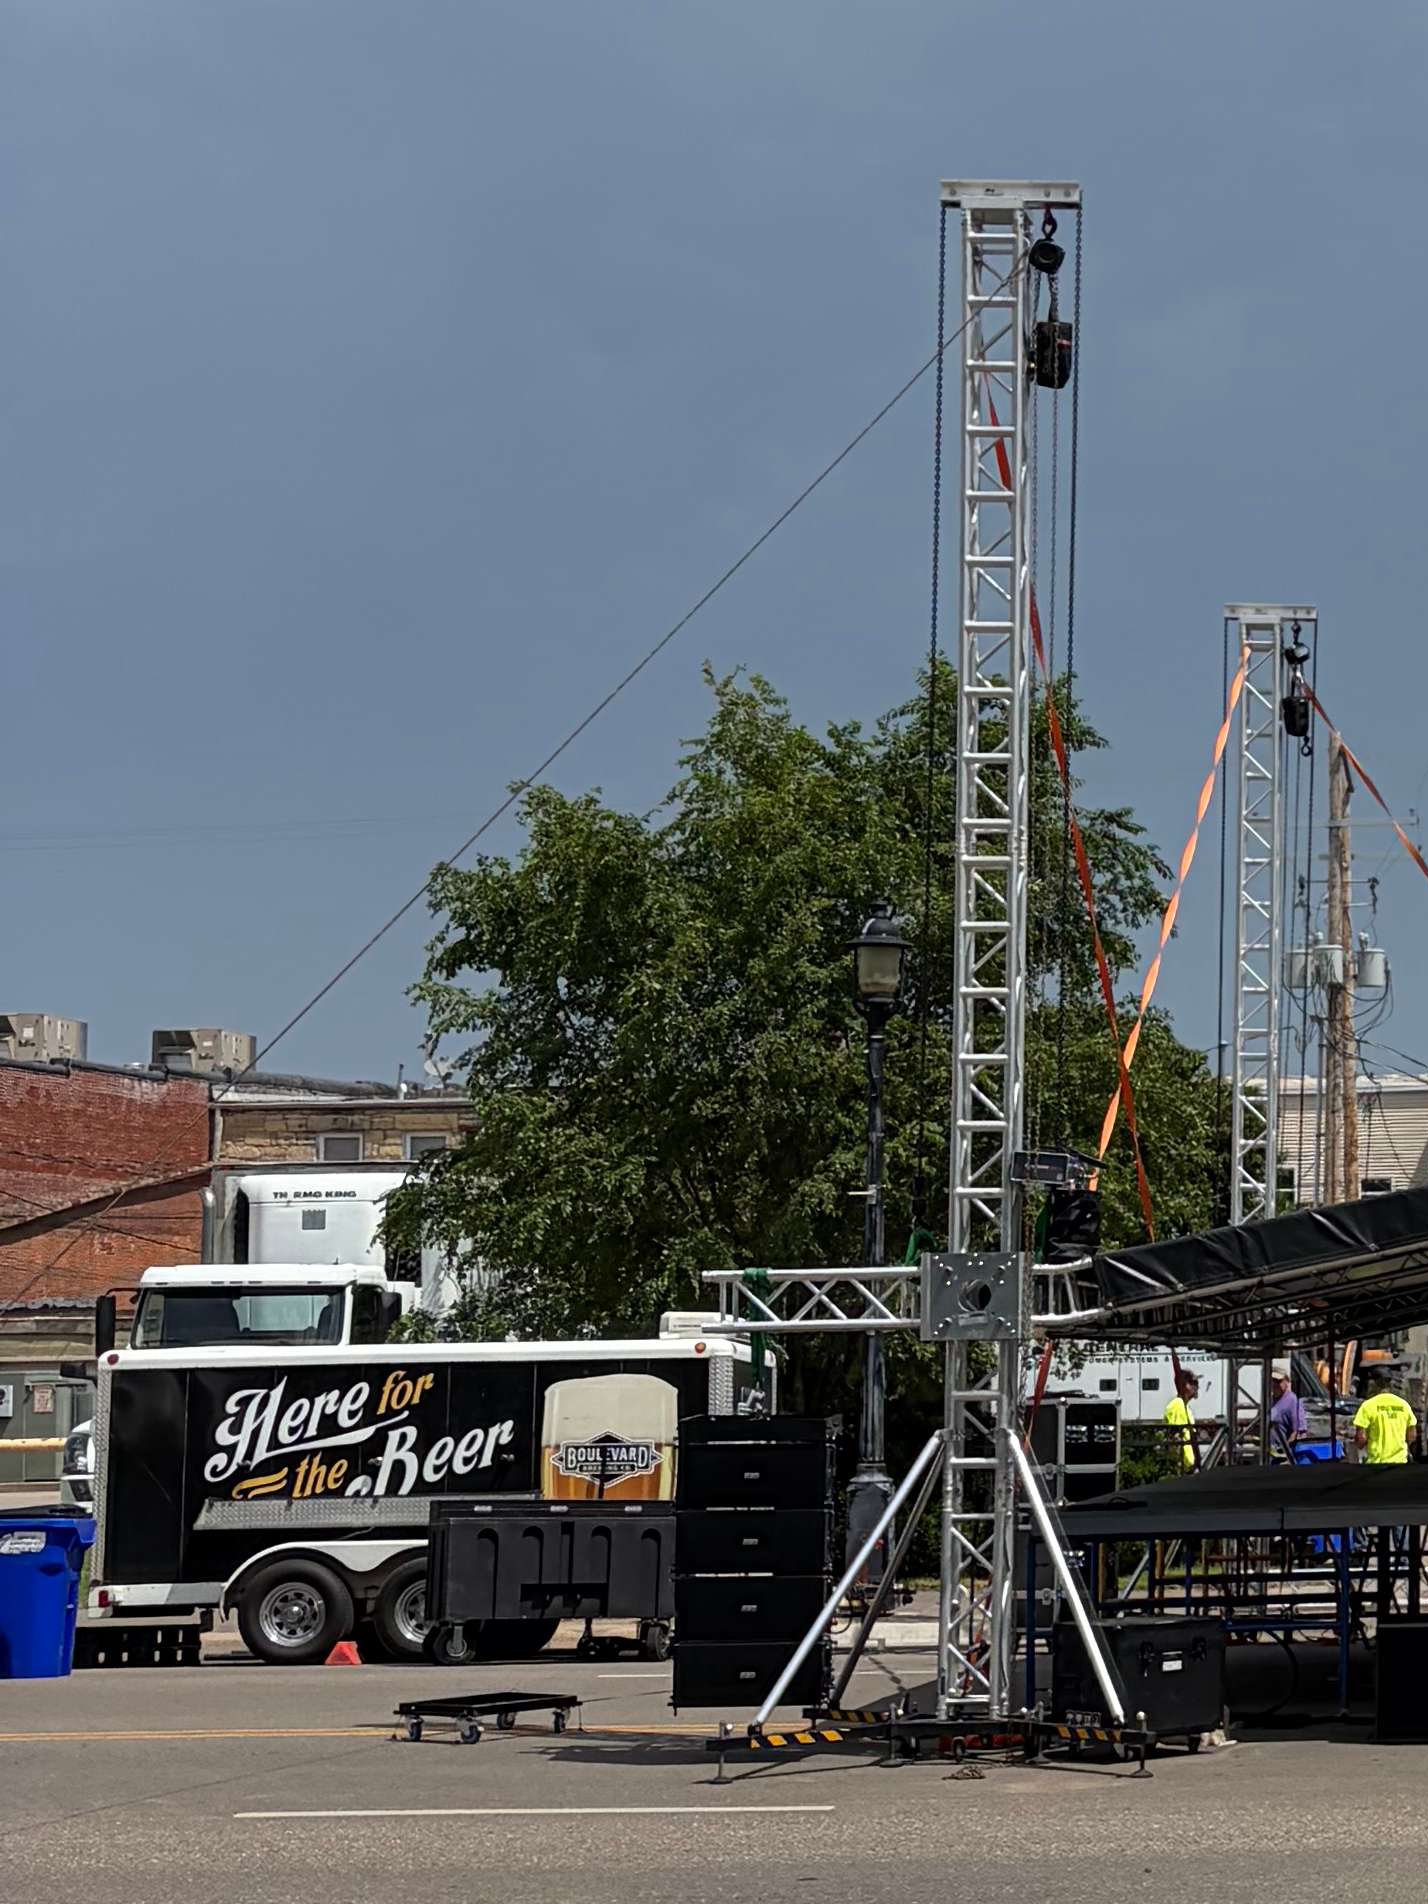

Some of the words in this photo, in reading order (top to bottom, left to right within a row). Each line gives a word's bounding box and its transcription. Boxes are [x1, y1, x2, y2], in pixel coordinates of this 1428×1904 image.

[273, 1191, 322, 1199] THRMO
[325, 1190, 357, 1198] KING
[204, 1375, 371, 1482] Here
[376, 1370, 434, 1415] for
[293, 1451, 348, 1498] the
[345, 1419, 514, 1496] Beer
[567, 1447, 648, 1469] BOULEVARD
